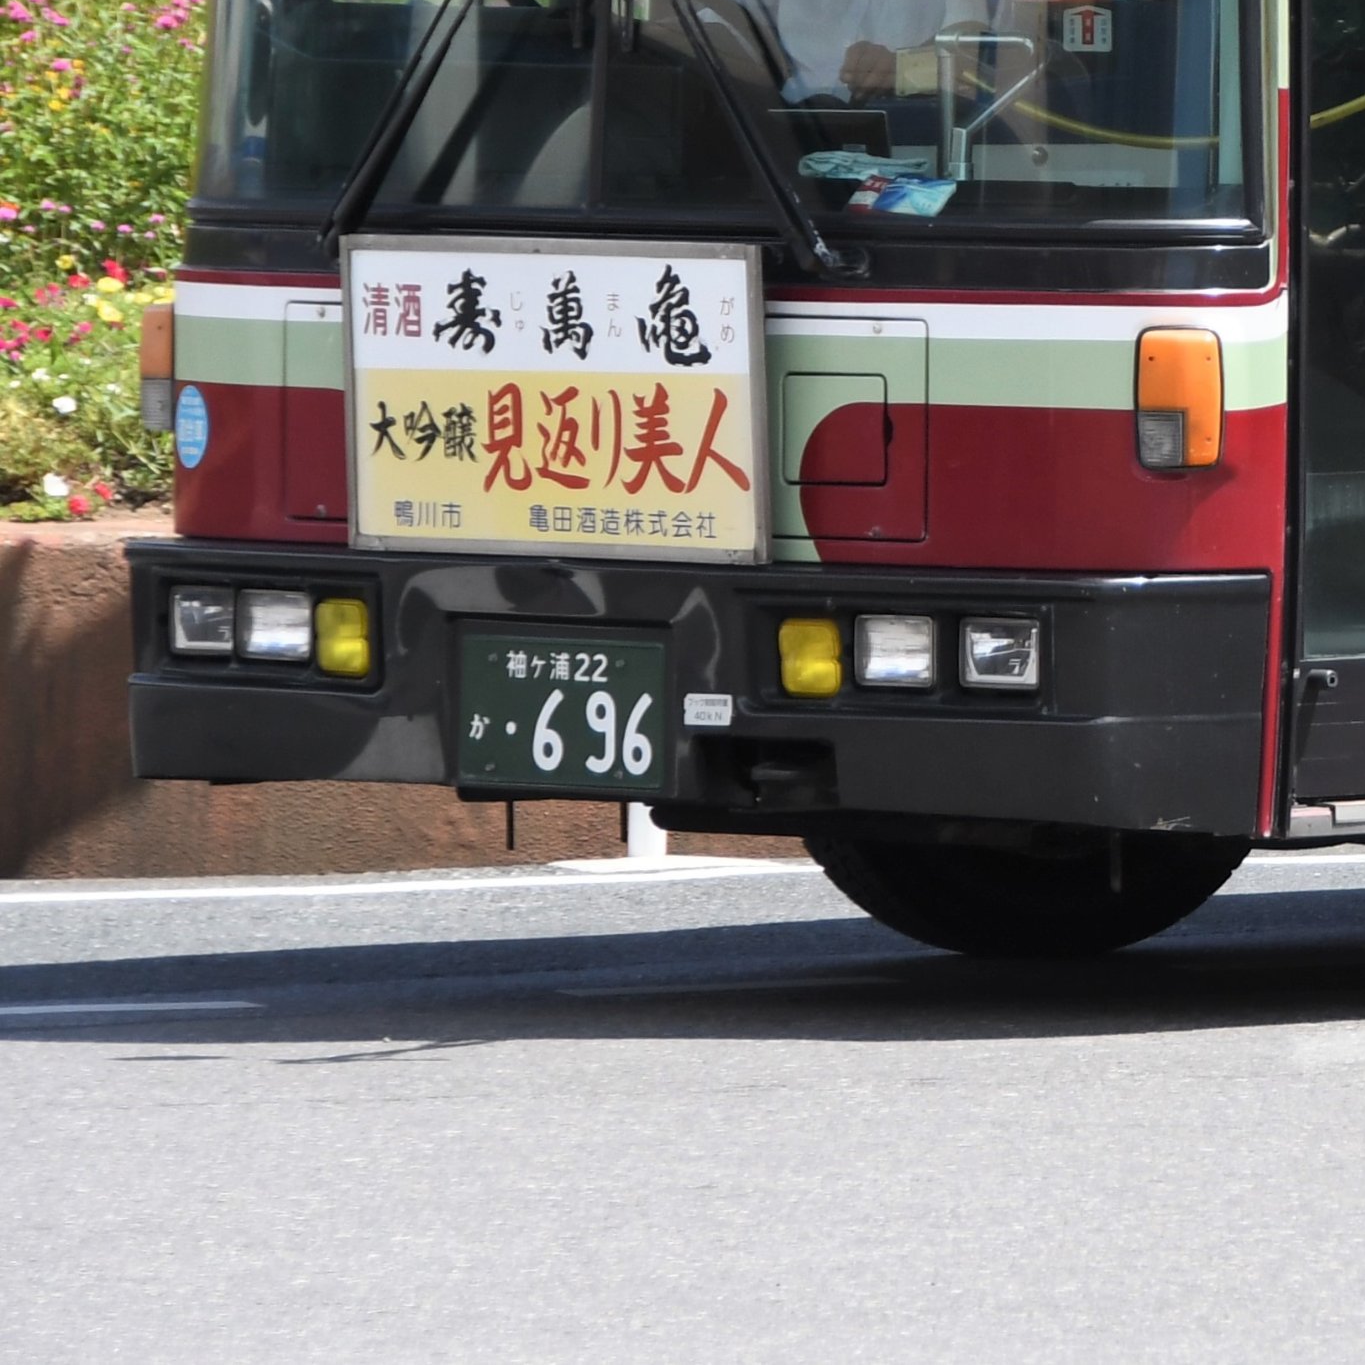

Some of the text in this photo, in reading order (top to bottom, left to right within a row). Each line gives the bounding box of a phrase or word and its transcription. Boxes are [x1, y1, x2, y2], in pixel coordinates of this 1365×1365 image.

[362, 282, 422, 338] 清酒
[480, 381, 752, 496] 見返り美人
[393, 500, 718, 540] 鴨川市 亀田酒造株式会社
[469, 714, 491, 740] か
